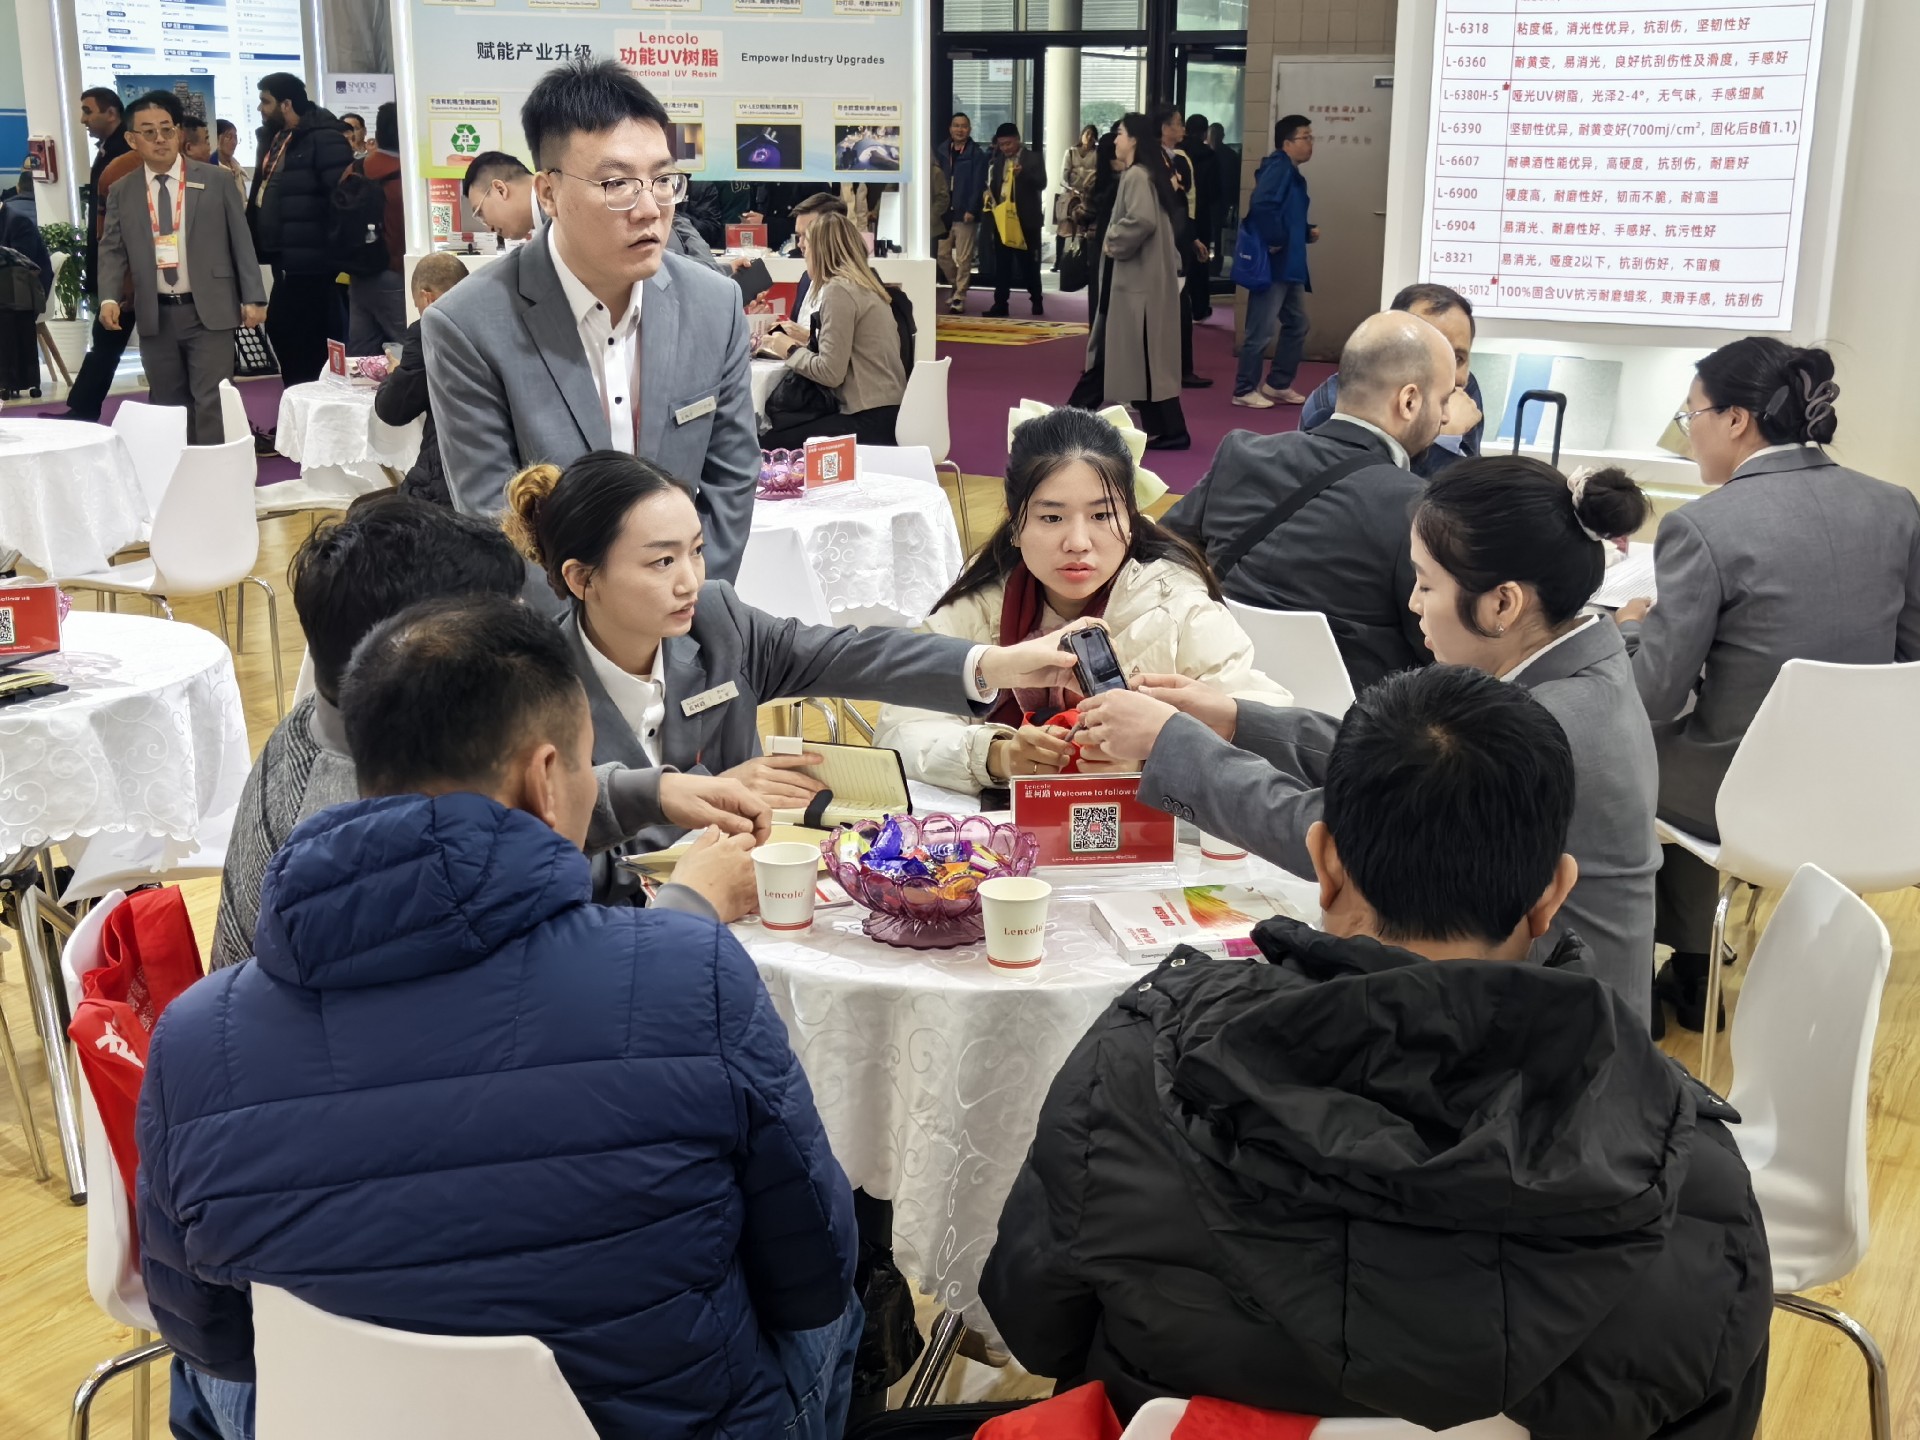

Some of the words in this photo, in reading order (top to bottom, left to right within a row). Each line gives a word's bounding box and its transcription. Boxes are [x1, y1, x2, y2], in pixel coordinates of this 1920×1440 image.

[1448, 22, 1489, 34] L-6318
[639, 31, 698, 45] Lencolo
[477, 42, 592, 61] 赋能产业升级
[620, 47, 718, 67] 功能UV树脂
[741, 53, 788, 65] Empower
[791, 54, 833, 65] Industry
[836, 55, 885, 65] Upgrades
[1446, 56, 1486, 68] L-6360
[1441, 122, 1482, 134] L-6390
[1439, 156, 1479, 167] L-6607
[1437, 188, 1478, 199] L-6900
[1435, 220, 1476, 231] L-6904
[1433, 252, 1473, 263] L-8321
[1469, 285, 1490, 296] 5012
[1054, 790, 1092, 798] Welcome
[1105, 788, 1131, 796] follow
[764, 889, 803, 898] Lencolo
[1003, 925, 1042, 937] Lencolo
